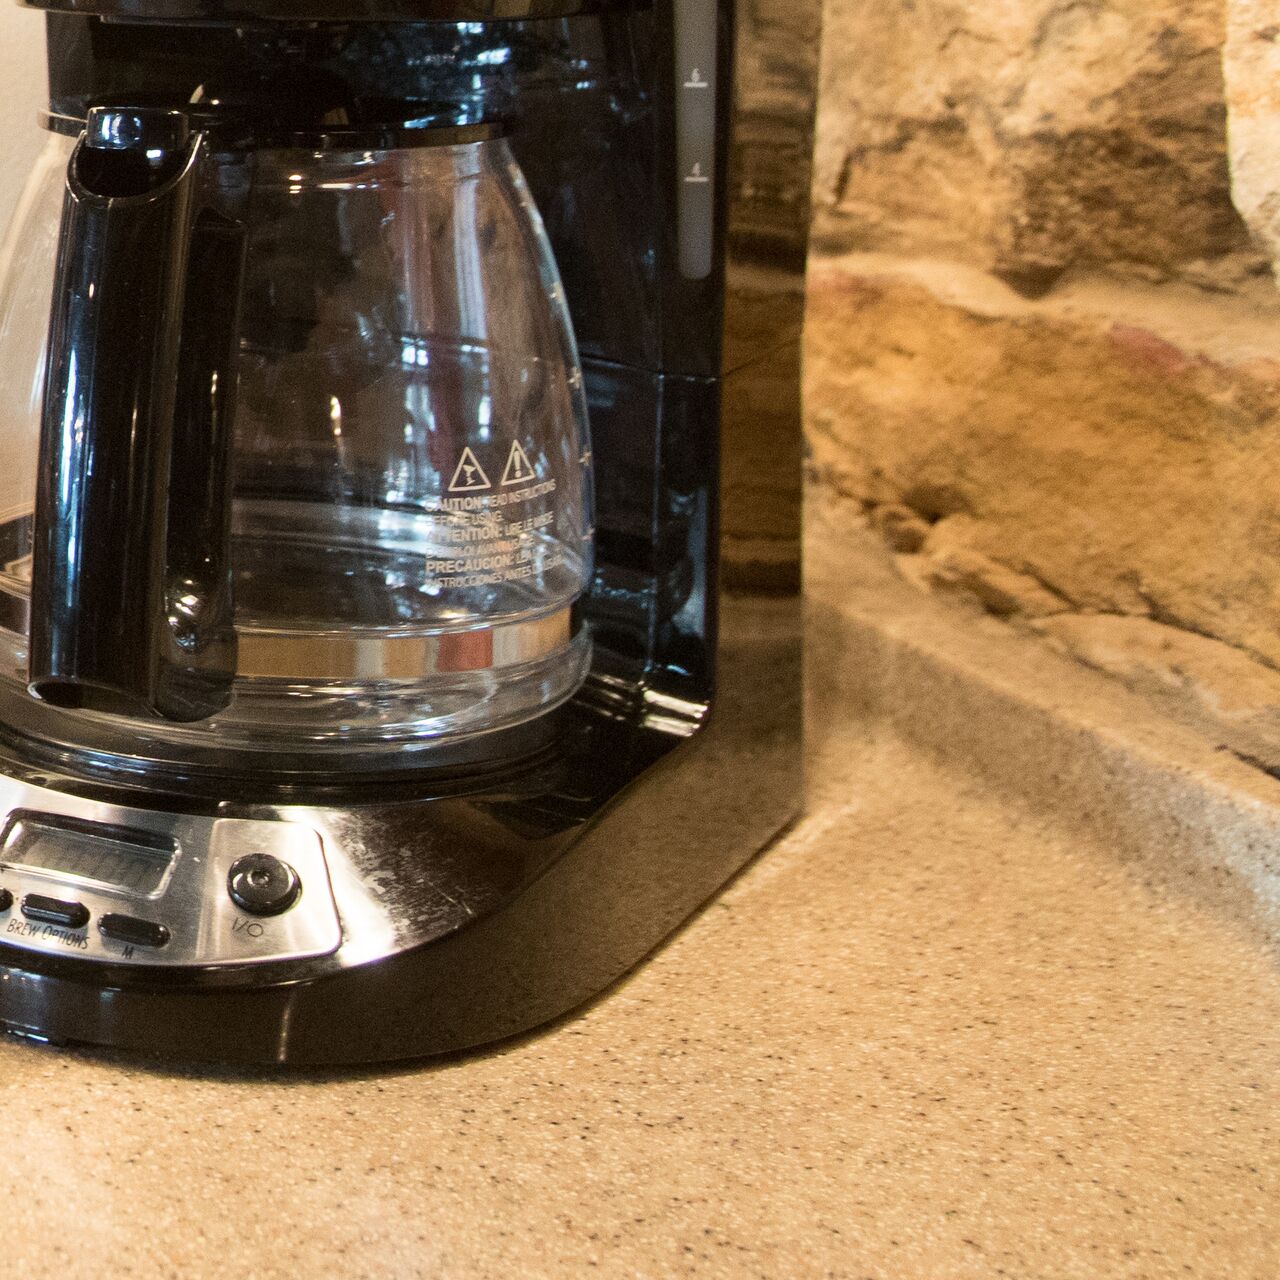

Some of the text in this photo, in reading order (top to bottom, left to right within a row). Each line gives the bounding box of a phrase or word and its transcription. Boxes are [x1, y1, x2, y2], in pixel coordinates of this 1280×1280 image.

[484, 493, 508, 508] EAD
[6, 918, 90, 951] BREW OPTIONS
